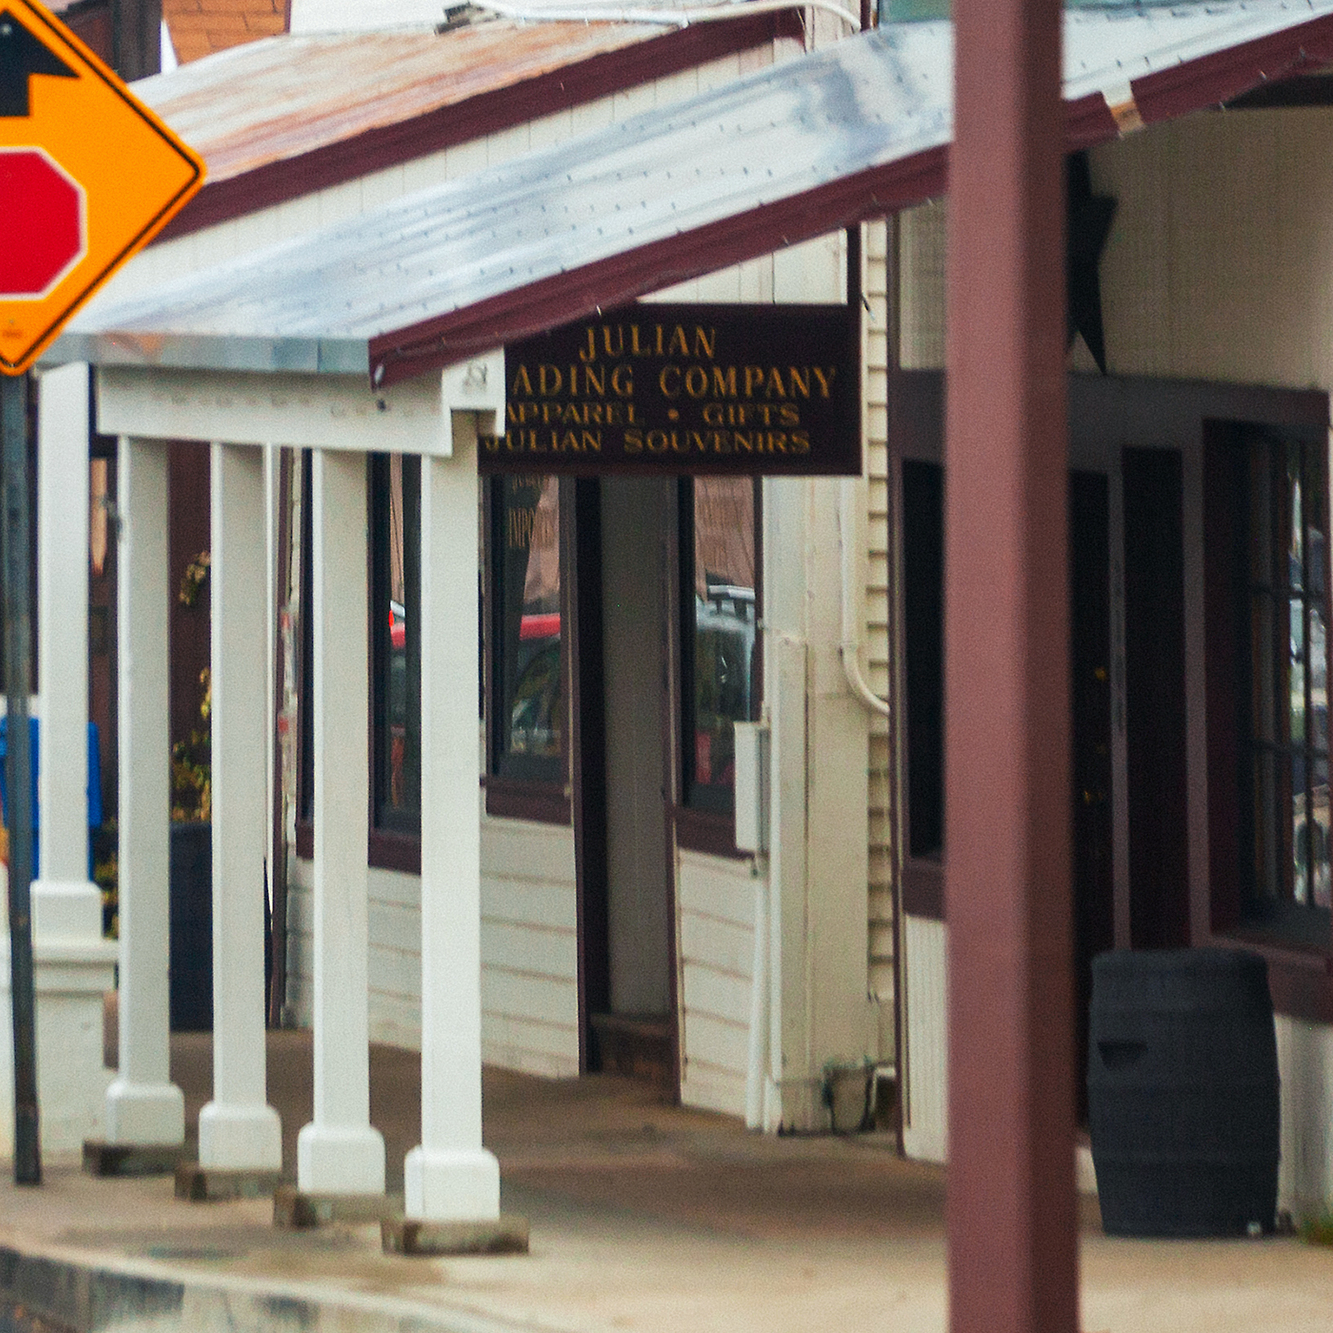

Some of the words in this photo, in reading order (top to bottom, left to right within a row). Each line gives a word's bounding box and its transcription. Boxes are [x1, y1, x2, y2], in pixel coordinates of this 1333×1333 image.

[579, 324, 717, 364] JULIAN
[512, 365, 634, 399] ADING
[658, 366, 836, 400] COMPANY
[505, 402, 646, 426] APPAREL
[702, 402, 800, 427] GIFTS
[484, 430, 603, 454] JULIAN
[623, 429, 812, 455] SOUVENIRS
